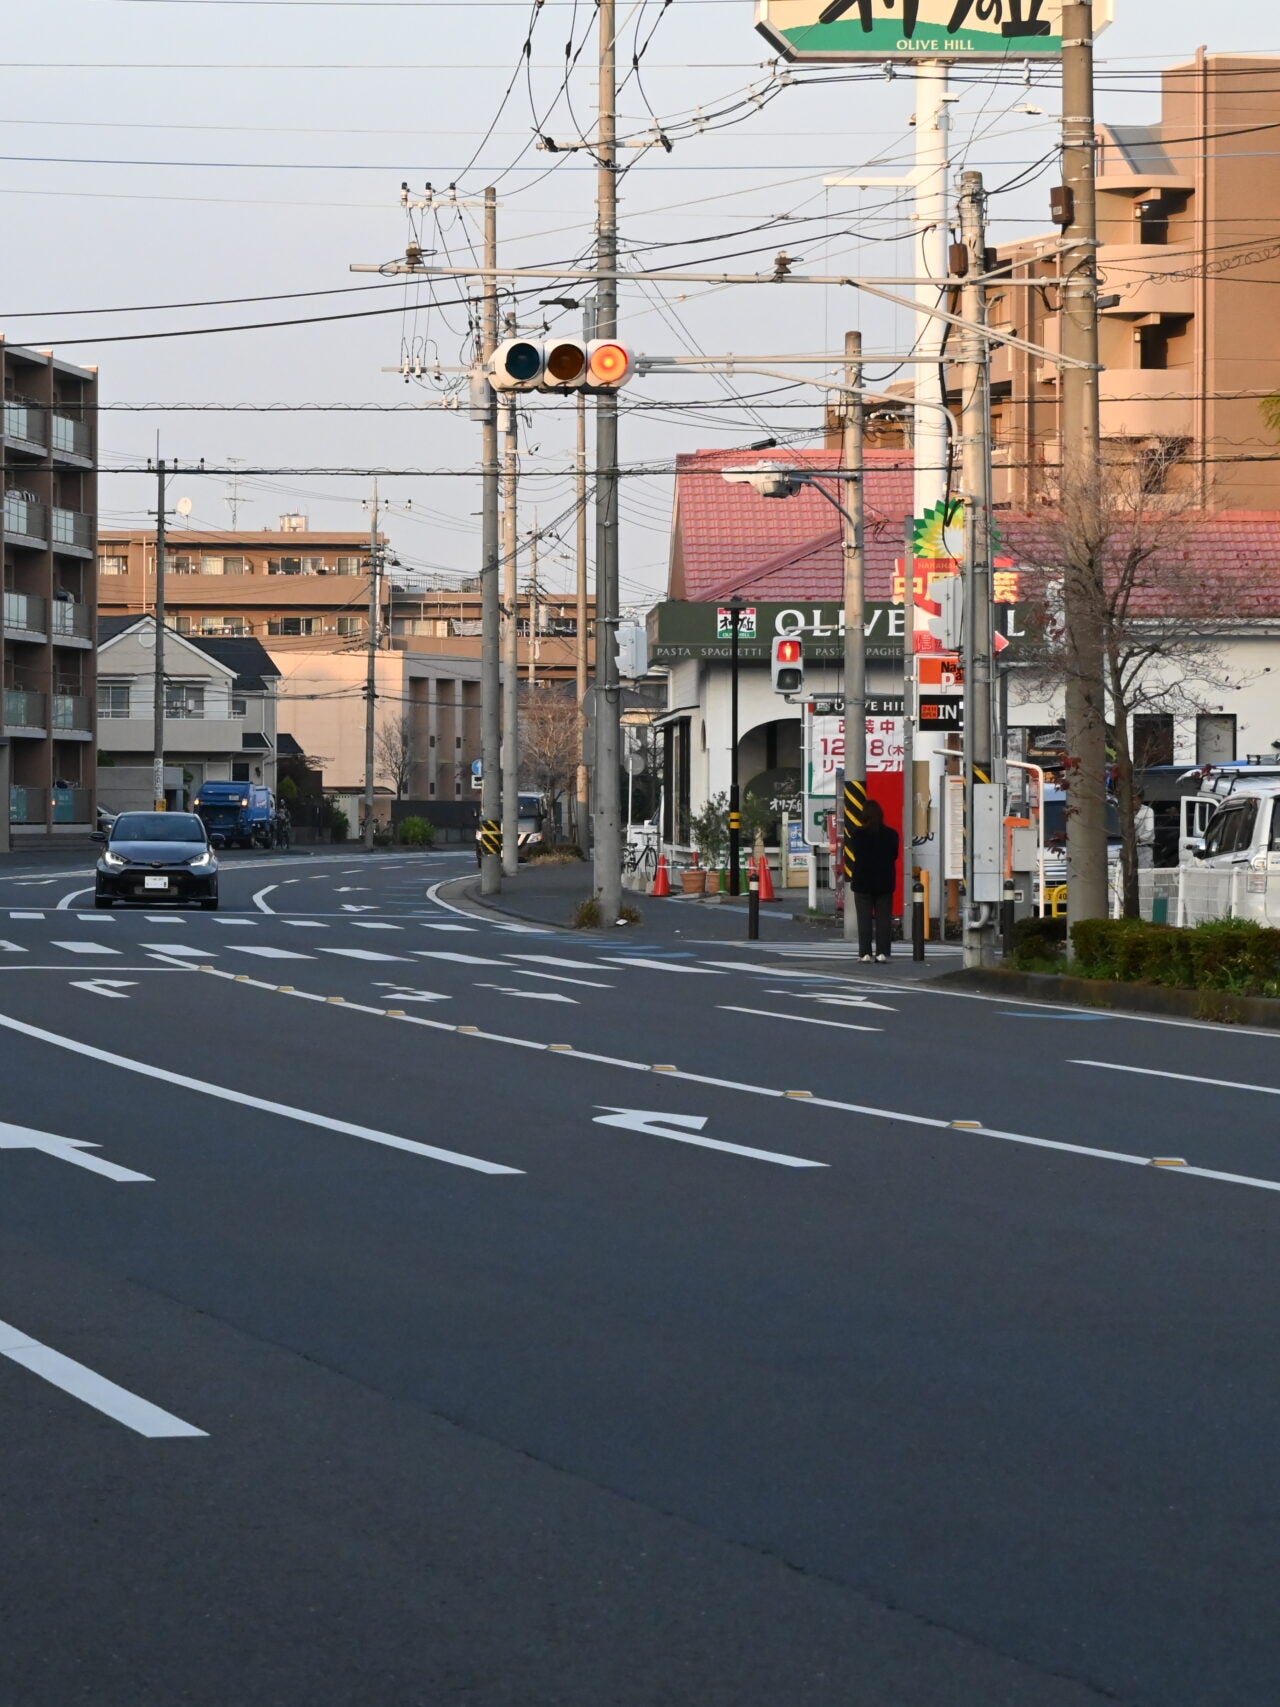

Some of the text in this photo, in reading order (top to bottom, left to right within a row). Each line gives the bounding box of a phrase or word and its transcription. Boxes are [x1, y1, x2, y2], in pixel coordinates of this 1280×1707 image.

[896, 39, 975, 51] OLIVE HILL
[657, 647, 692, 657] PASTA
[938, 705, 957, 719] IN
